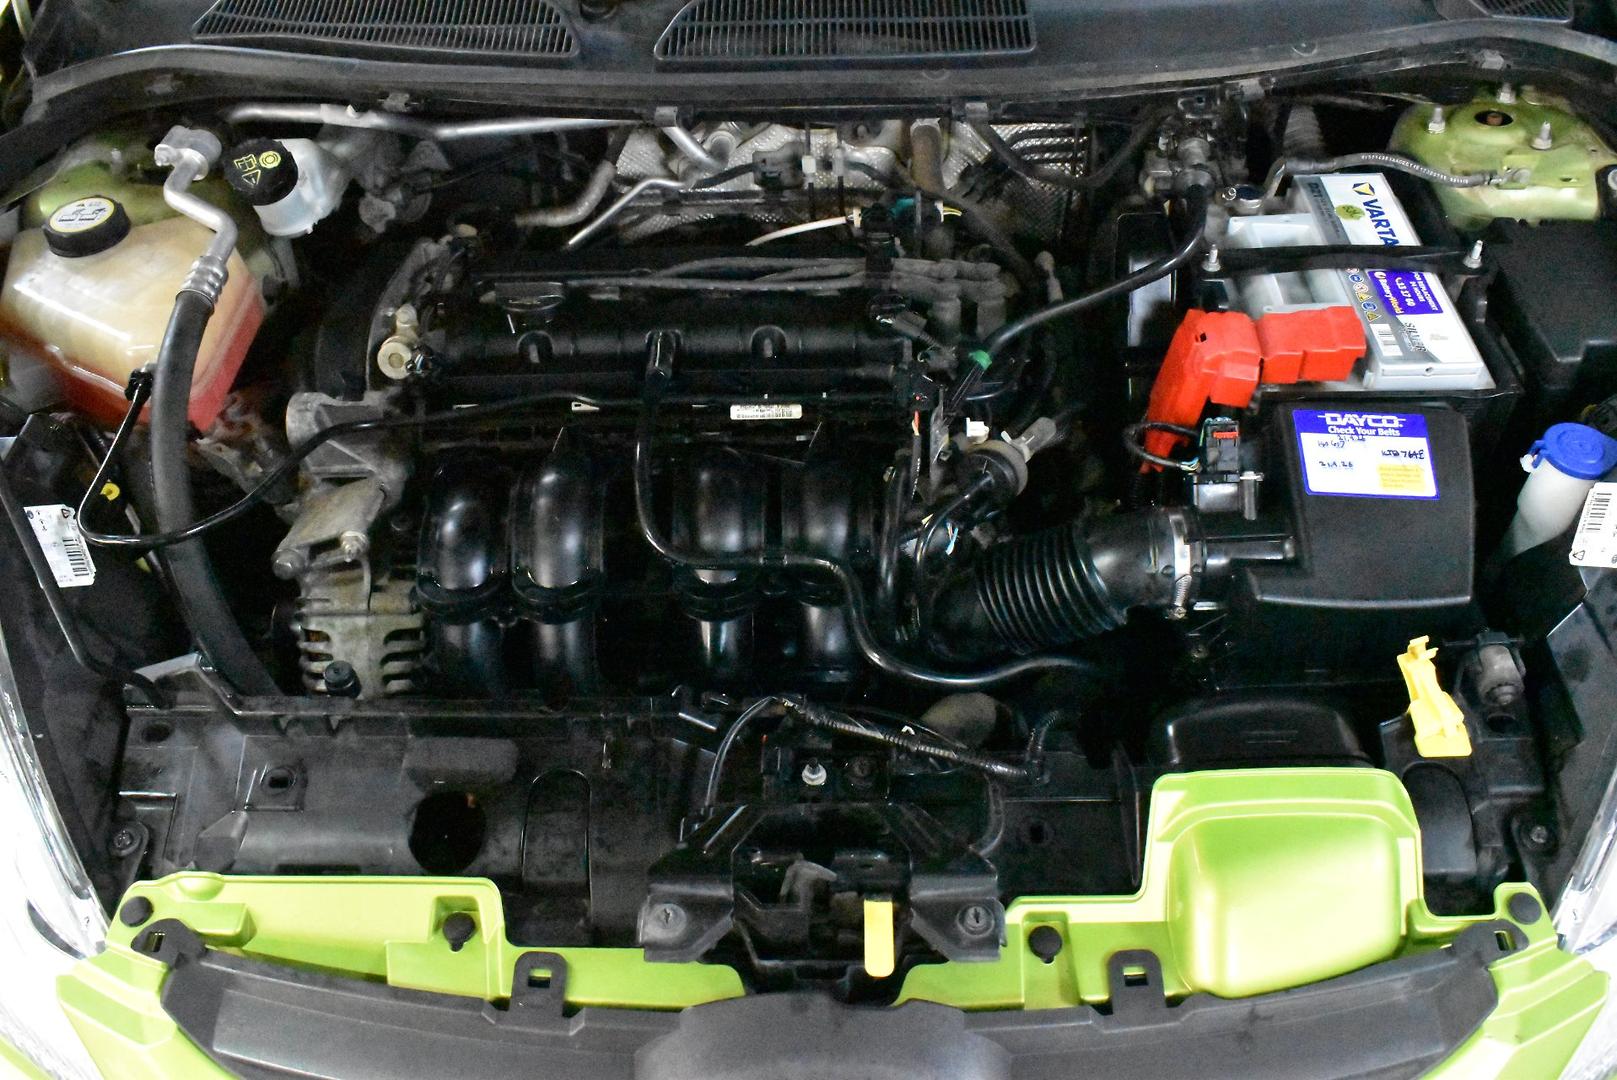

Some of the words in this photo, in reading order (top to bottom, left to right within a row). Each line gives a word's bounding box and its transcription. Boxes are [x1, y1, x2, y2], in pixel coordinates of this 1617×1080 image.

[1363, 199, 1400, 248] VARTA
[1325, 413, 1400, 428] DAYCO
[1328, 426, 1355, 435] Check
[1356, 427, 1377, 436] Your
[1378, 428, 1401, 437] Belts
